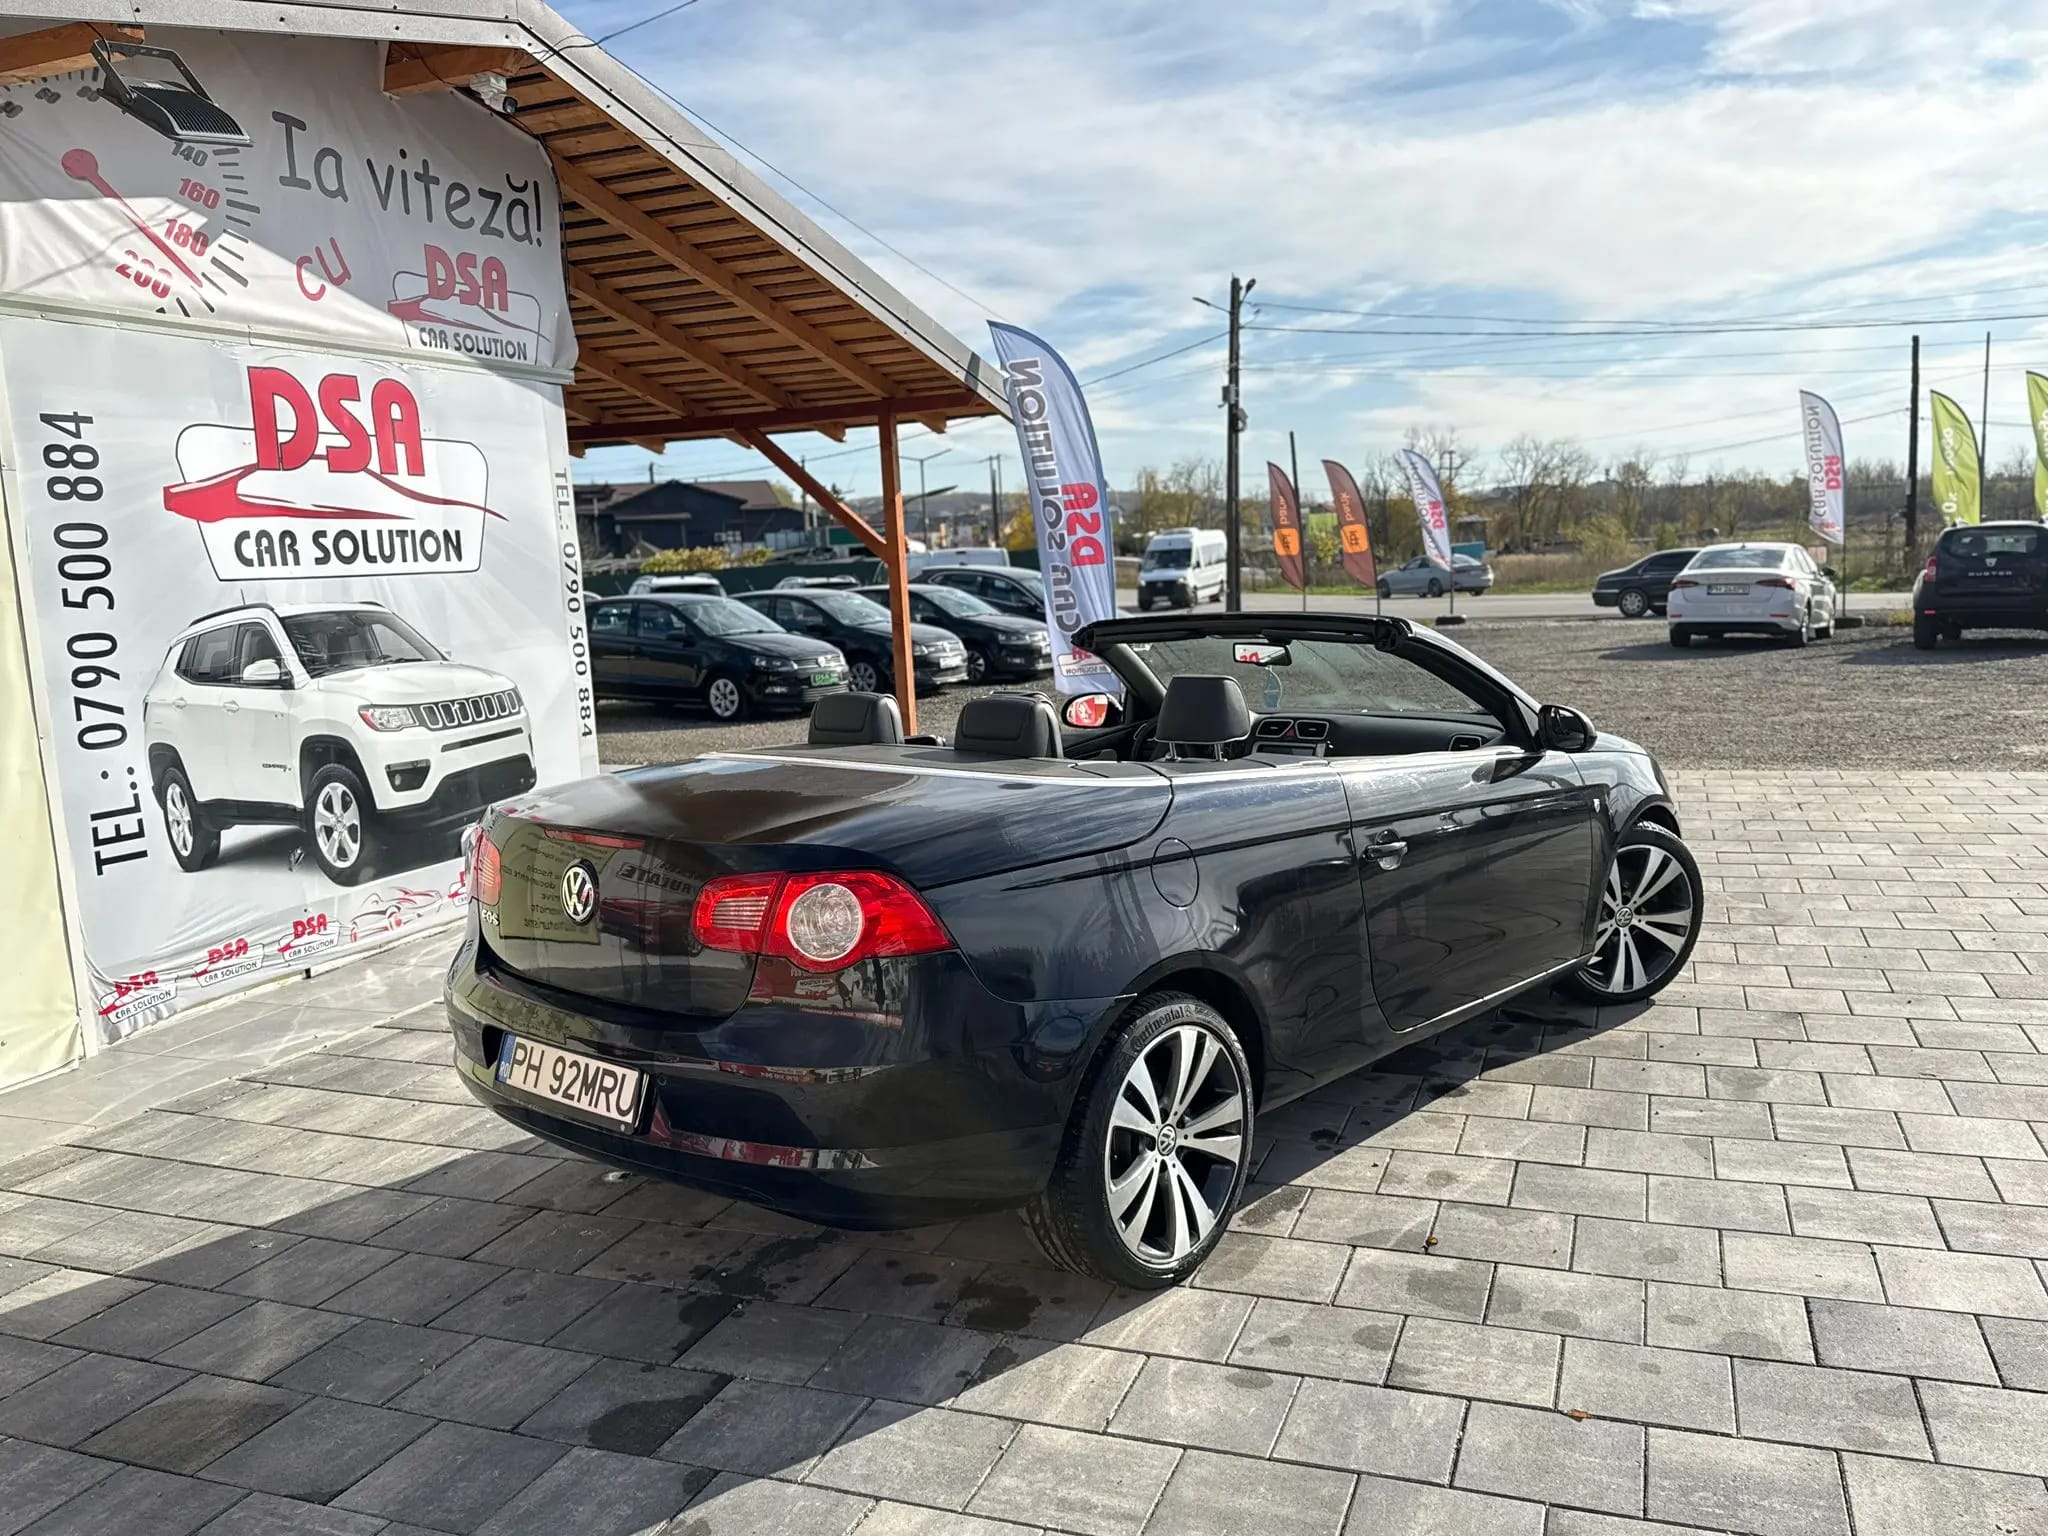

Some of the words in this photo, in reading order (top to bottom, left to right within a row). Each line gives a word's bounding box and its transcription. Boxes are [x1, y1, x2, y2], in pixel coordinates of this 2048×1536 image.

[171, 141, 209, 167] 140
[178, 177, 221, 210] 160
[271, 110, 349, 203] Ia
[366, 148, 543, 248] viteză!
[164, 218, 209, 257] 180
[295, 236, 352, 302] cu
[423, 243, 509, 313] DSA
[419, 327, 449, 350] CAR
[453, 331, 528, 362] SOLUTION
[246, 366, 427, 477] DSA
[39, 410, 104, 502] 884
[53, 522, 116, 612] 500
[234, 529, 302, 568] CAR
[314, 529, 464, 567] SOLUTION
[562, 542, 582, 614] 0790
[569, 624, 588, 677] 500
[66, 632, 128, 750] 0790
[578, 687, 593, 738] 884
[89, 764, 149, 876] TEL.:
[292, 913, 328, 939] DSA
[482, 908, 500, 926] EOS
[207, 938, 249, 965] DSA
[288, 948, 302, 958] CAR
[303, 939, 335, 953] SOLUTION
[204, 972, 219, 984] CAR
[220, 961, 258, 978] SOLUTION
[115, 1006, 132, 1019] CAR
[133, 989, 172, 1012] SOLUTION
[499, 1060, 510, 1080] RO
[508, 1041, 545, 1089] PH
[548, 1055, 635, 1118] 92MRU
